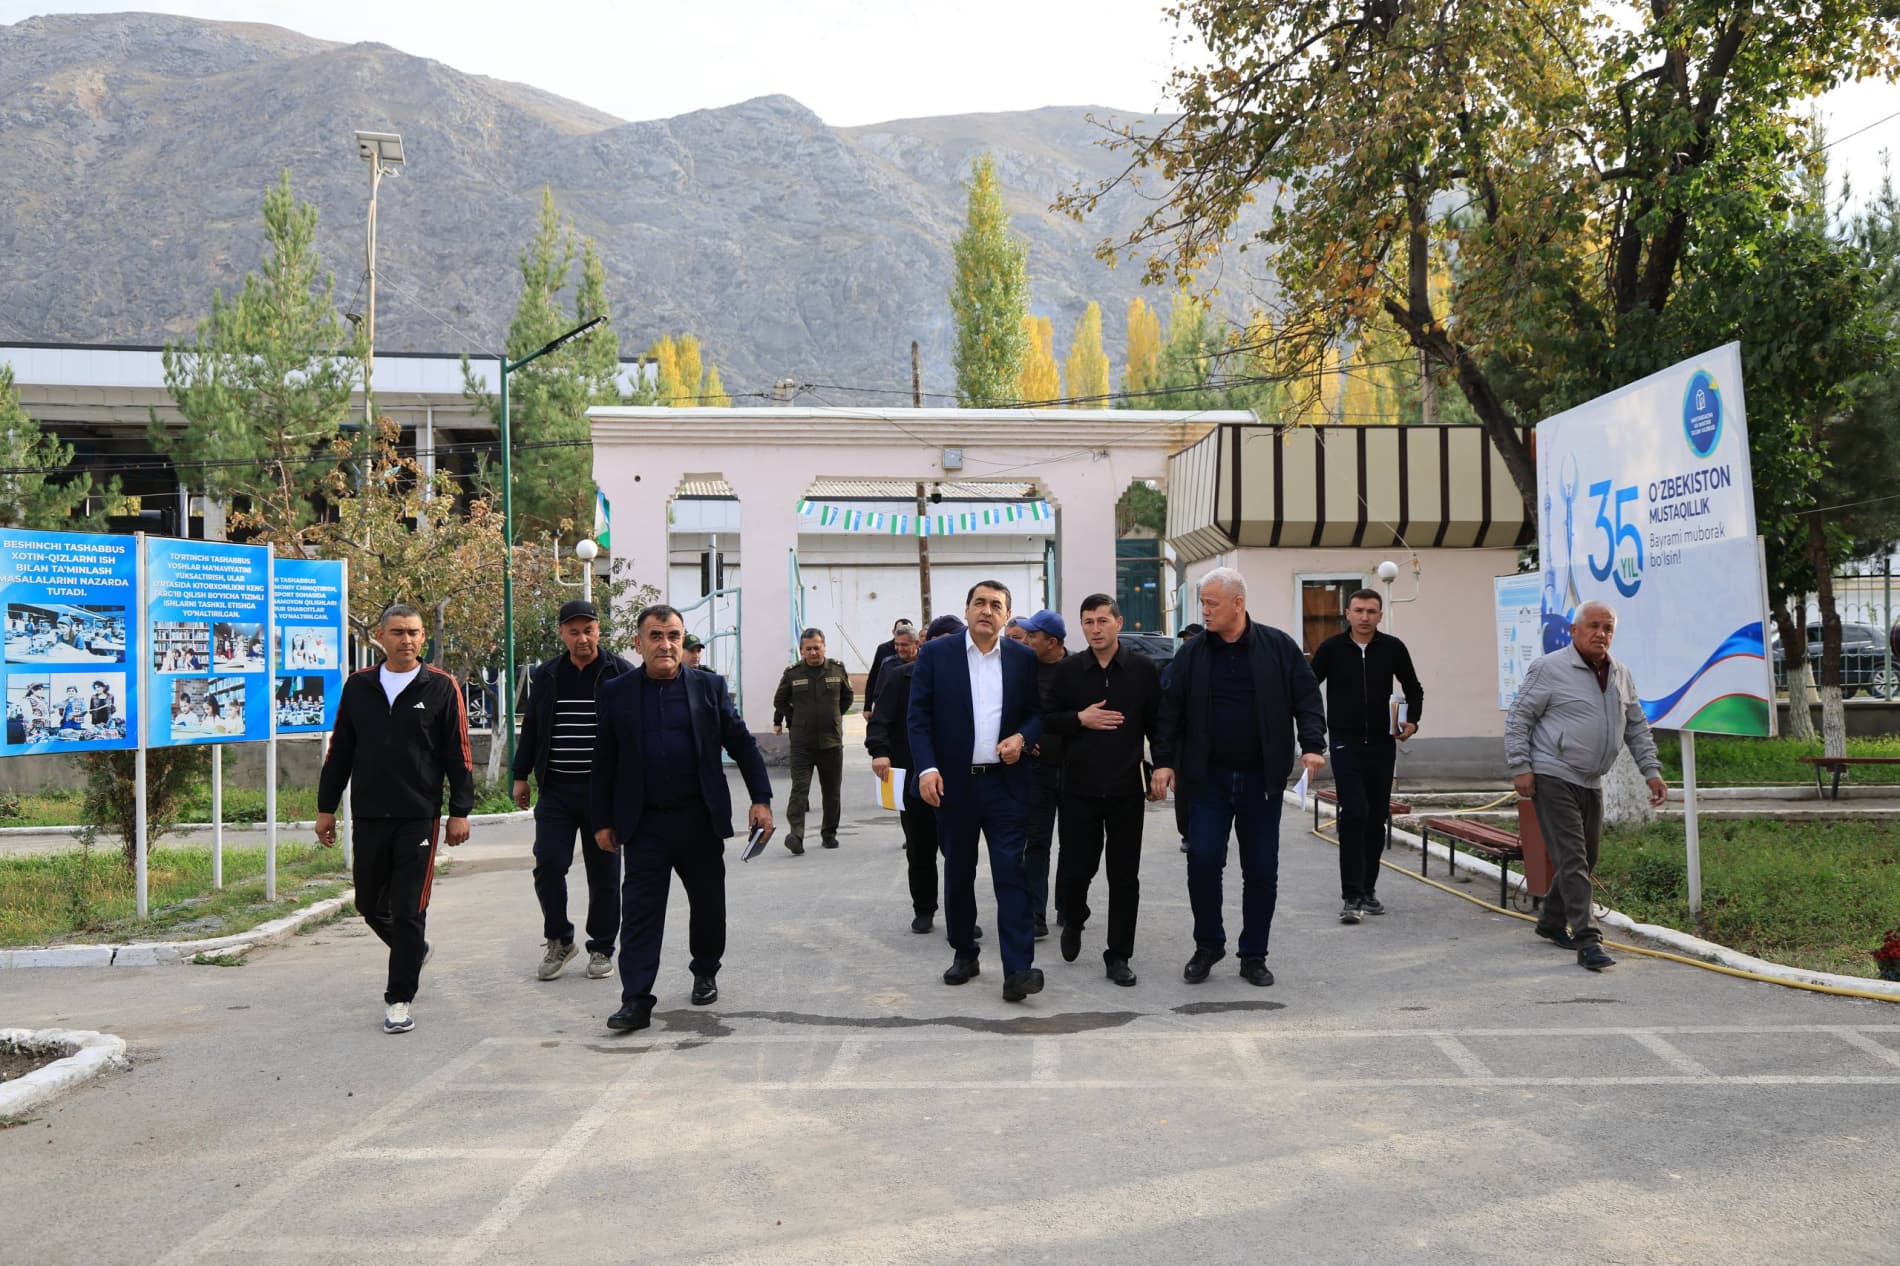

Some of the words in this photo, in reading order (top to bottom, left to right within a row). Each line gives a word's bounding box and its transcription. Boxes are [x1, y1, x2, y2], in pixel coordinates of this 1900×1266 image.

[1648, 464, 1731, 503] O'ZBEKISTON
[1649, 497, 1711, 524] MUSTAQILLIK
[1588, 479, 1643, 598] 35
[1649, 529, 1682, 550] Bayrami
[1684, 521, 1726, 543] muborak
[3, 540, 61, 550] BESHINCHI
[64, 543, 125, 554] TASHABBUS
[11, 552, 97, 563] XOTIN-QIZLARNI
[99, 556, 116, 564] ISH
[211, 555, 251, 565] TASHABBUS
[1650, 549, 1682, 568] bo'lsin!
[16, 563, 48, 573] BILAN
[51, 565, 112, 575] TA'MINLASH
[167, 562, 201, 571] YOSHLAR
[1620, 557, 1639, 579] YIL
[80, 578, 129, 587] NAZARDA
[46, 587, 87, 597] TUTADI.
